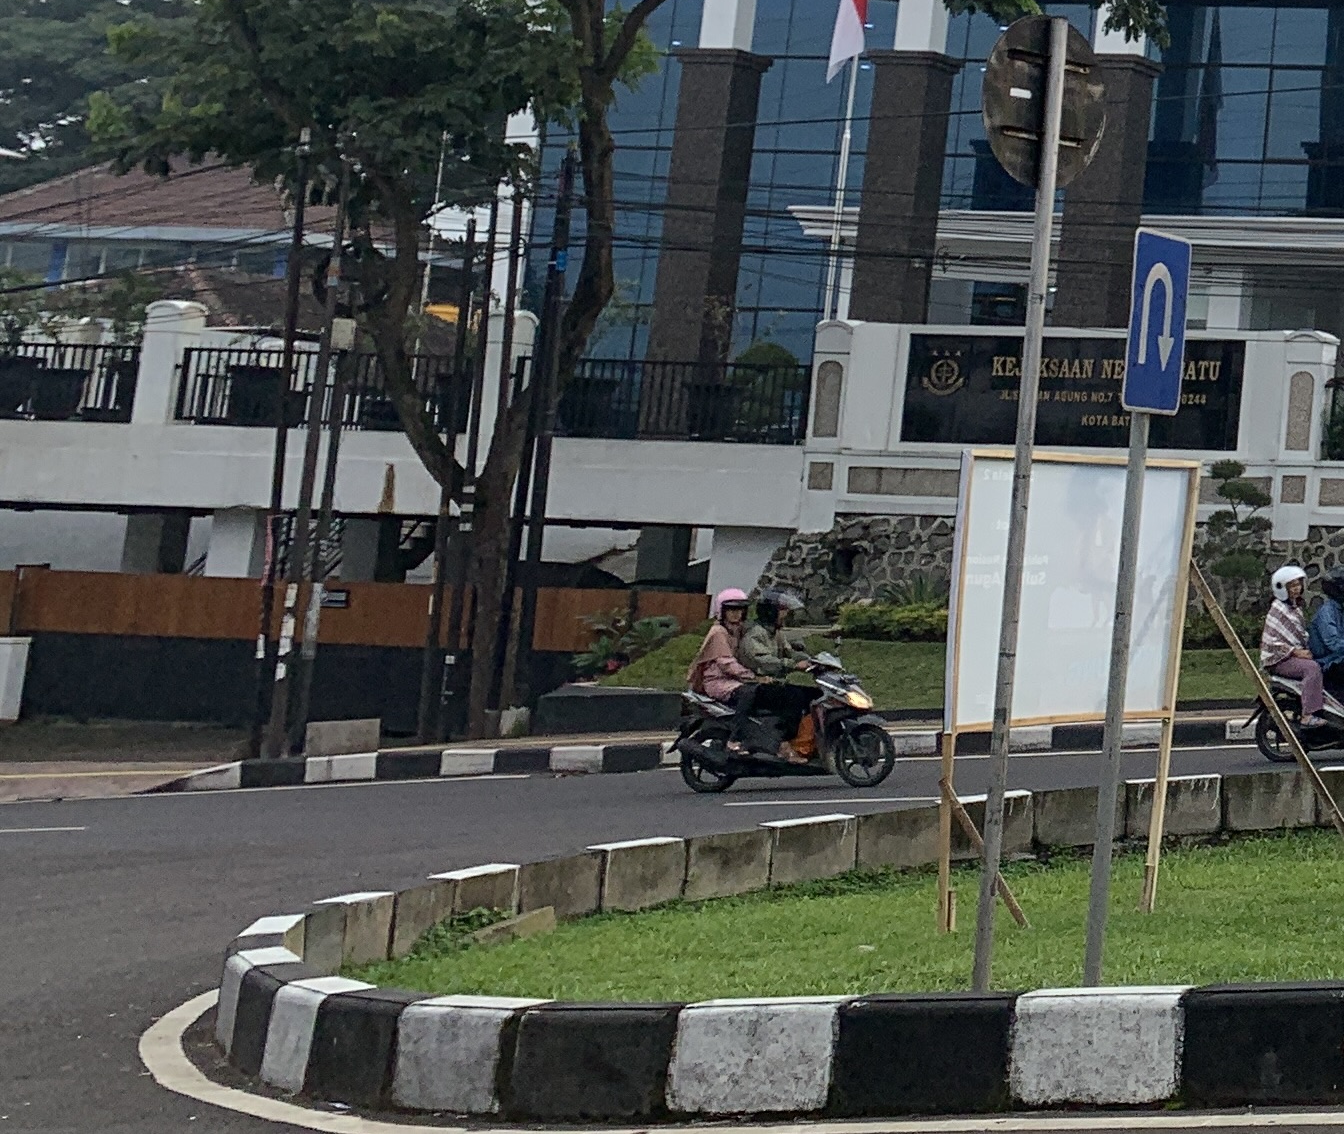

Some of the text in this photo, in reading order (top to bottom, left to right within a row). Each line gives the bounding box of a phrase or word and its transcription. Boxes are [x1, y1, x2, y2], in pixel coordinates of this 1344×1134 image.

[991, 356, 1095, 379] KEJKSAAN
[1183, 361, 1221, 381] ATU
[1081, 415, 1131, 426] KOTA BAT
